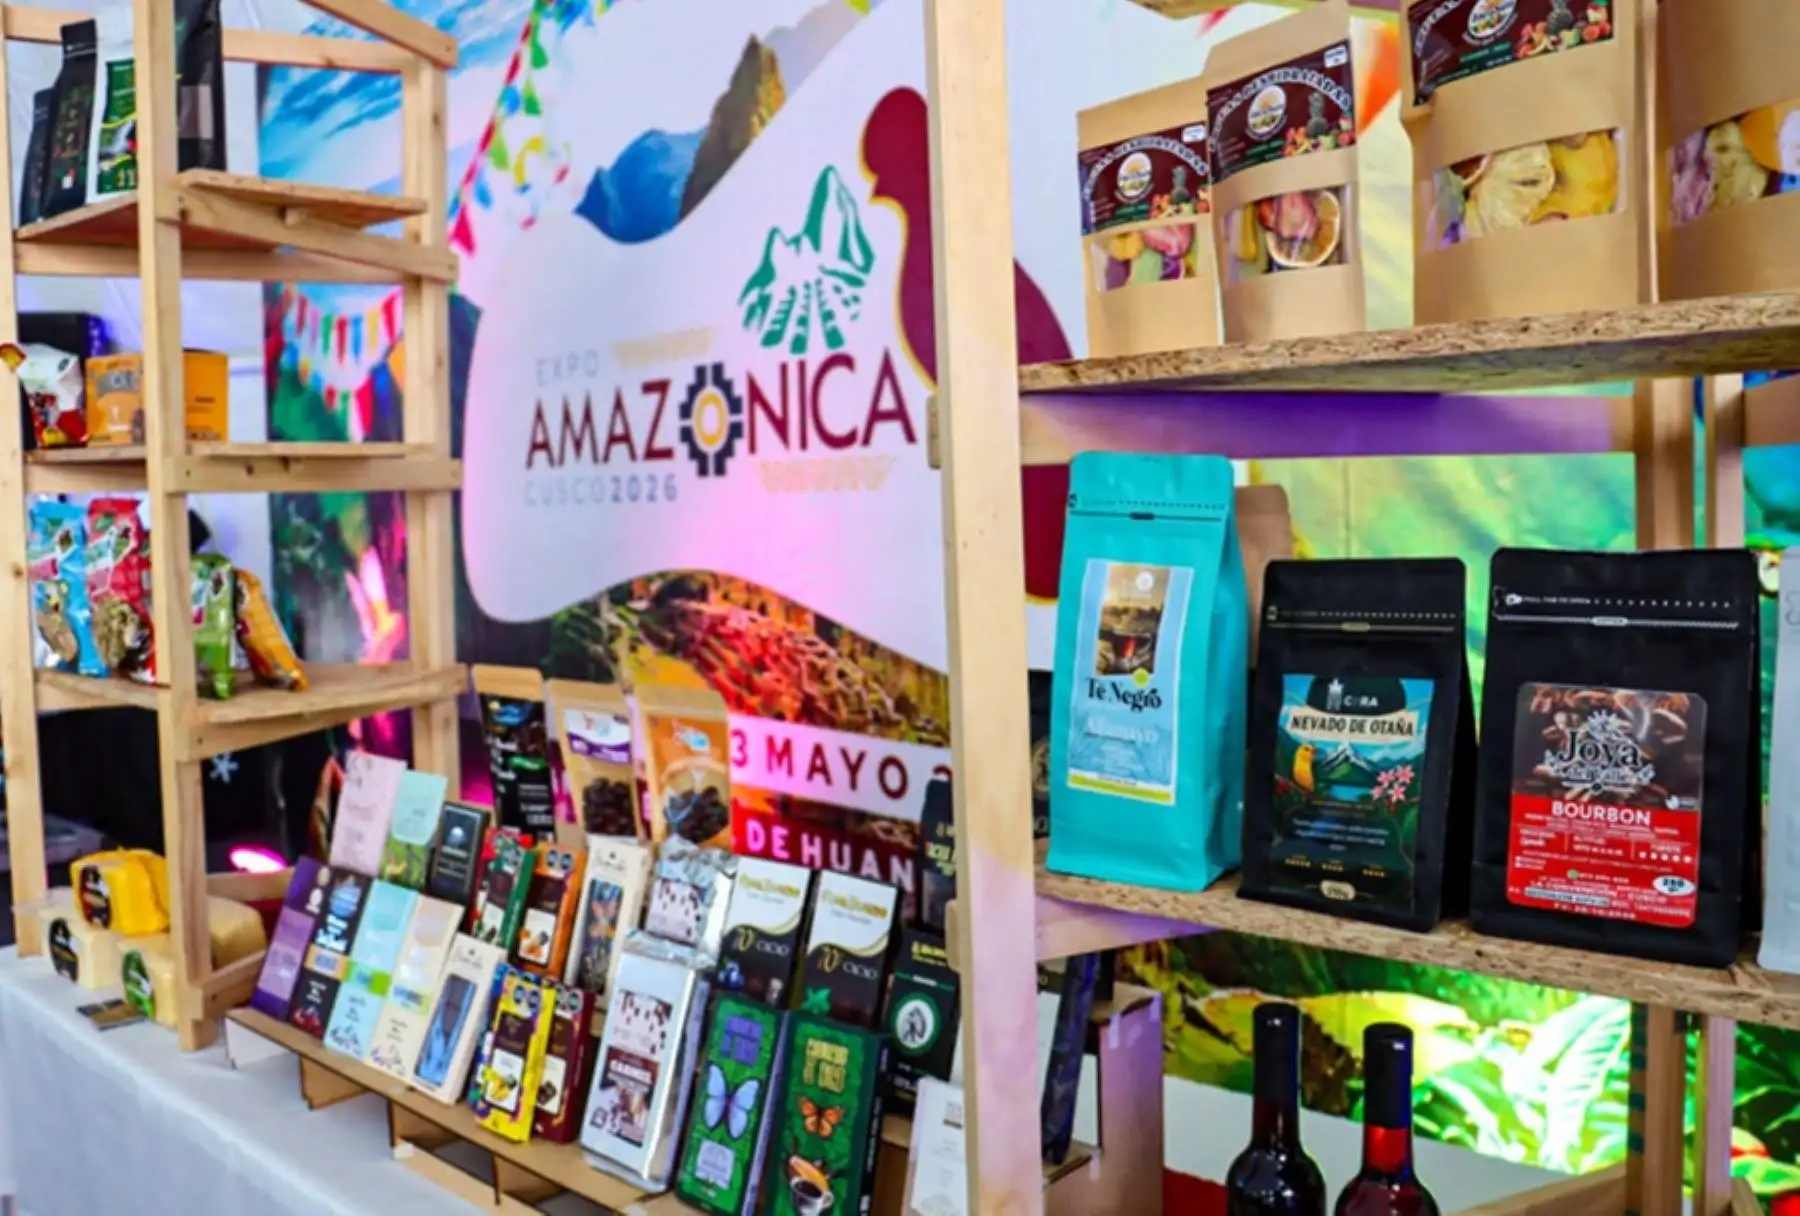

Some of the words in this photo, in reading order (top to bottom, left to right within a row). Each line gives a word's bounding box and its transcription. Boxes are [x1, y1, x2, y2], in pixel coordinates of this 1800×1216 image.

[536, 349, 599, 388] EXPO
[1291, 715, 1347, 733] NEVADO
[1349, 719, 1365, 735] DE
[1369, 717, 1414, 737] OTAÑA
[766, 735, 908, 799] MAYO
[1558, 728, 1640, 768] Joya
[1551, 800, 1651, 826] BOURBON
[745, 818, 790, 859] DE
[800, 832, 914, 893] HUAN
